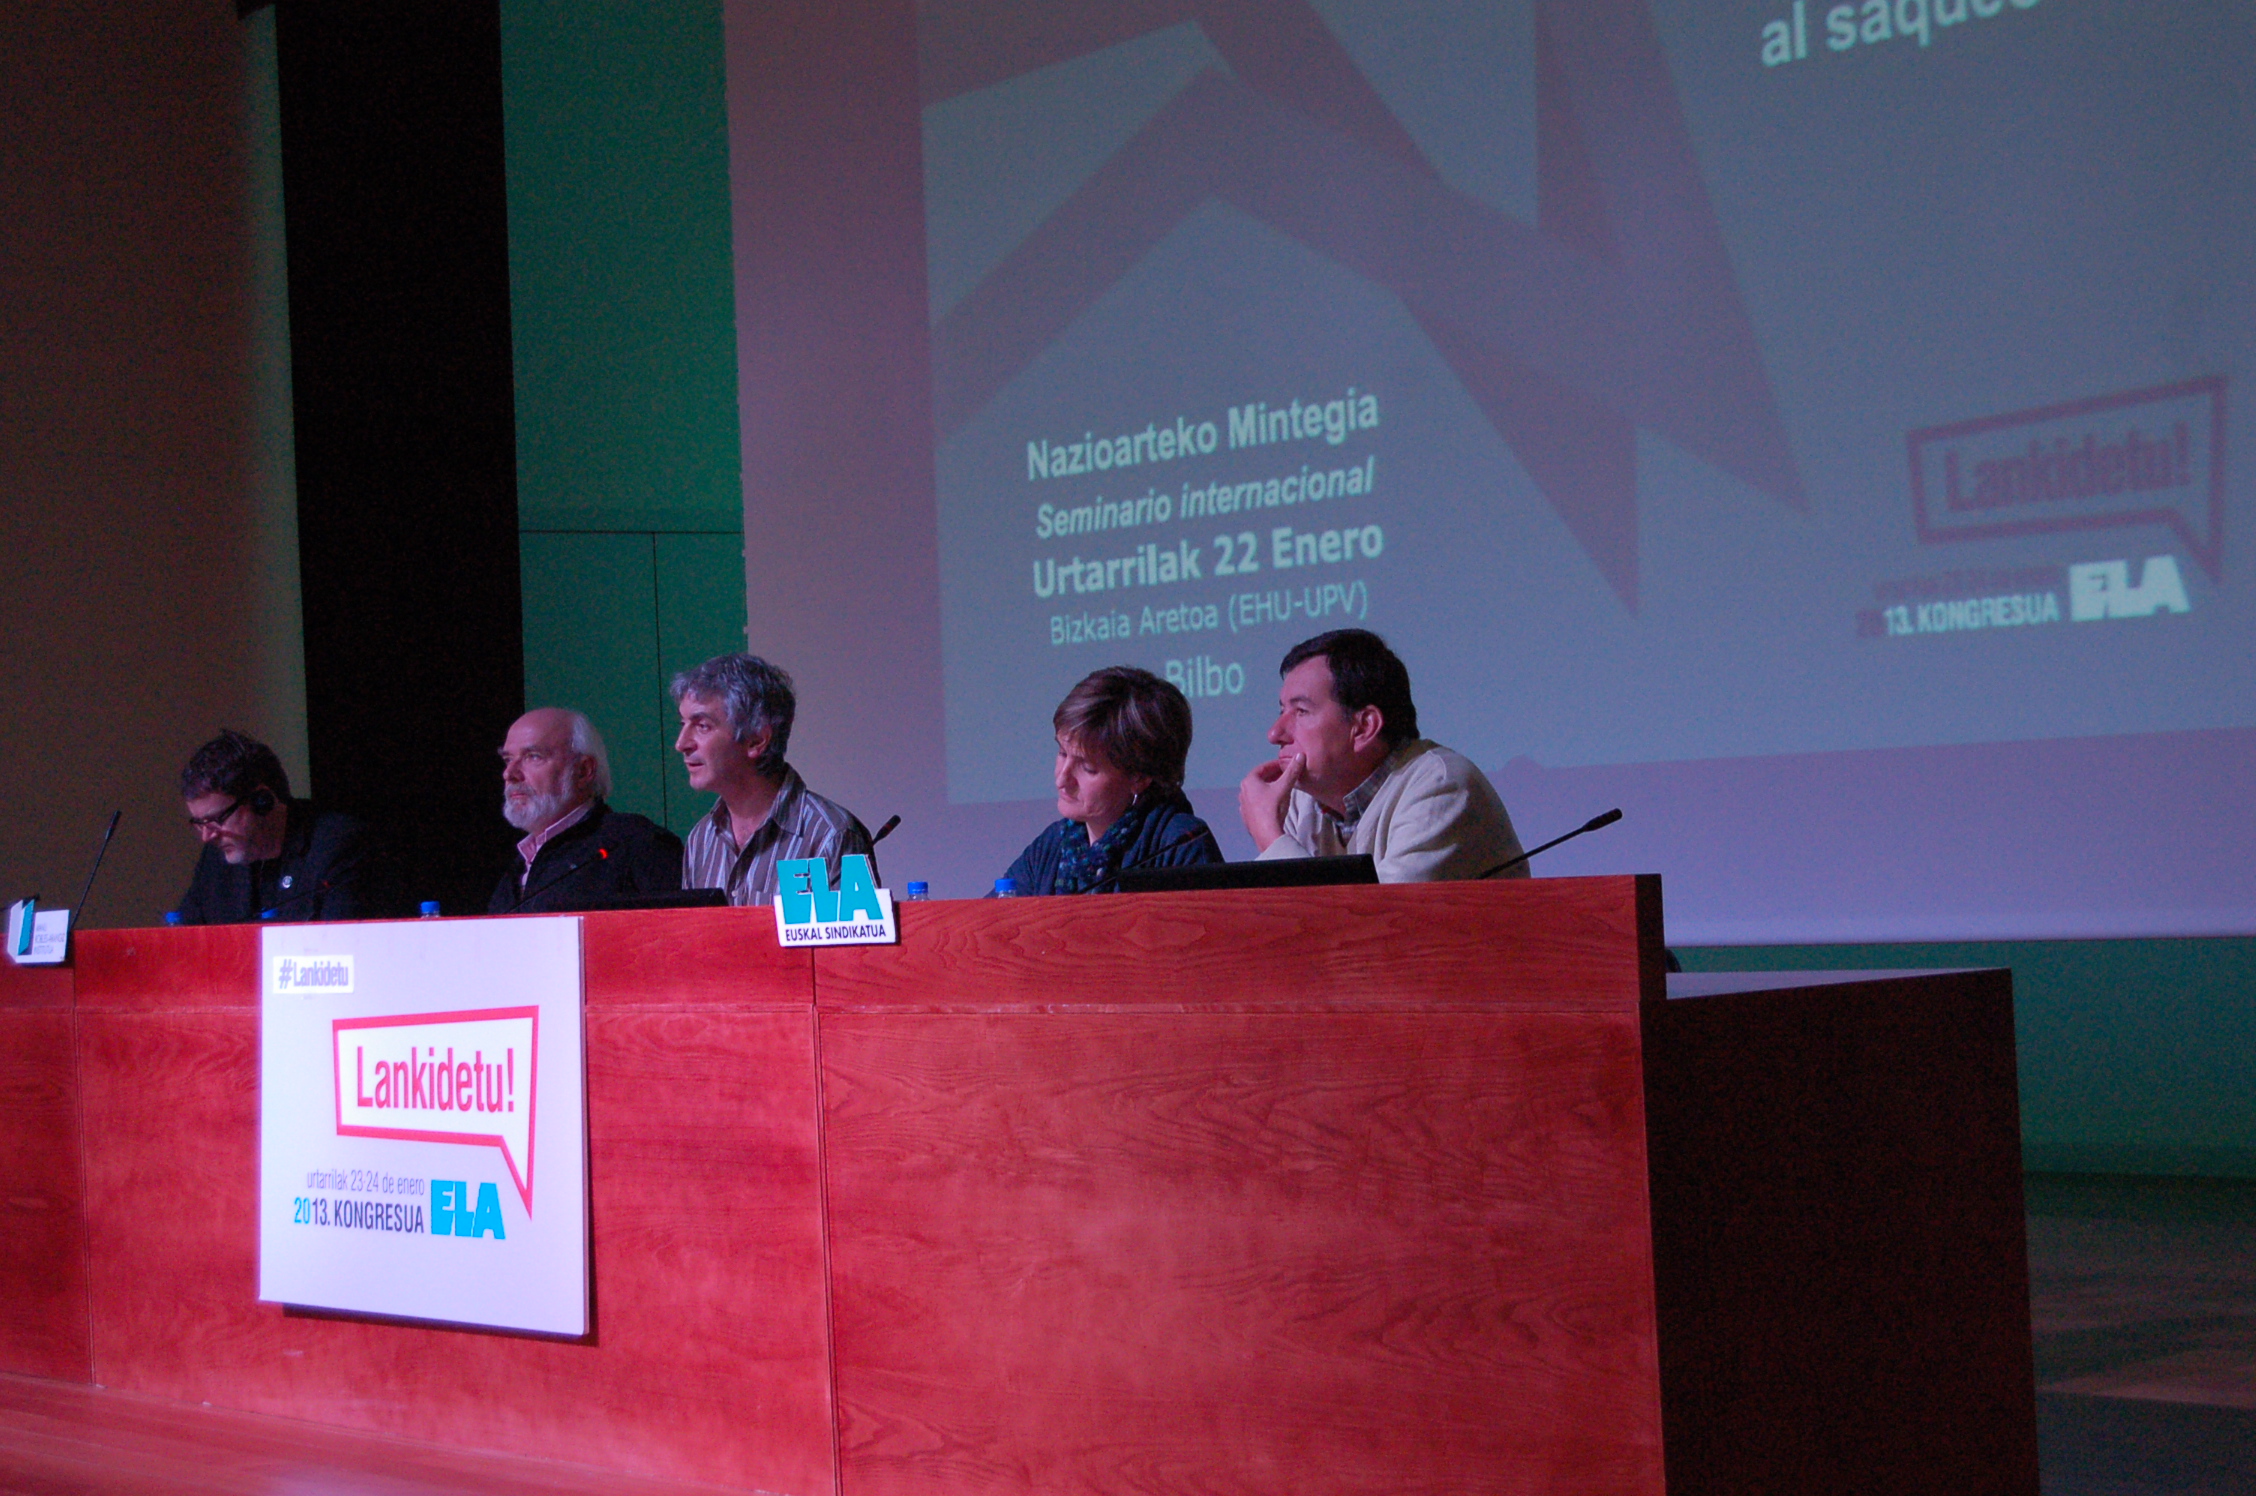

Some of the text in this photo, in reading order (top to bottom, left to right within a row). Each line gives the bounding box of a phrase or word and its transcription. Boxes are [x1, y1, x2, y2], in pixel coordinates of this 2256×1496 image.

[1761, 0, 2041, 67] al saqu
[1027, 387, 1379, 480] Nazioarteko Mintegia
[1945, 420, 2193, 512] Lankidetu!
[1036, 455, 1375, 539] Seminario internacional
[1033, 524, 1384, 598] Urtarrilak 22 Enero
[1918, 592, 2060, 633] KONGRESUA
[2068, 554, 2191, 622] ELA
[1051, 580, 1368, 646] Bizkaia Aretoa (EHU-UPV)
[1165, 655, 1245, 698] Bilbo
[776, 854, 884, 925] ELA
[785, 924, 887, 941] EUSKAL SINDIKATUA
[279, 959, 349, 989] #Lankidetu
[357, 1046, 515, 1113] Lankidetu!
[307, 1169, 347, 1191] urtarrilak
[382, 1172, 394, 1193] de
[397, 1176, 425, 1196] enero
[431, 1179, 506, 1239] ELA
[334, 1200, 424, 1233] KONGRESUA
